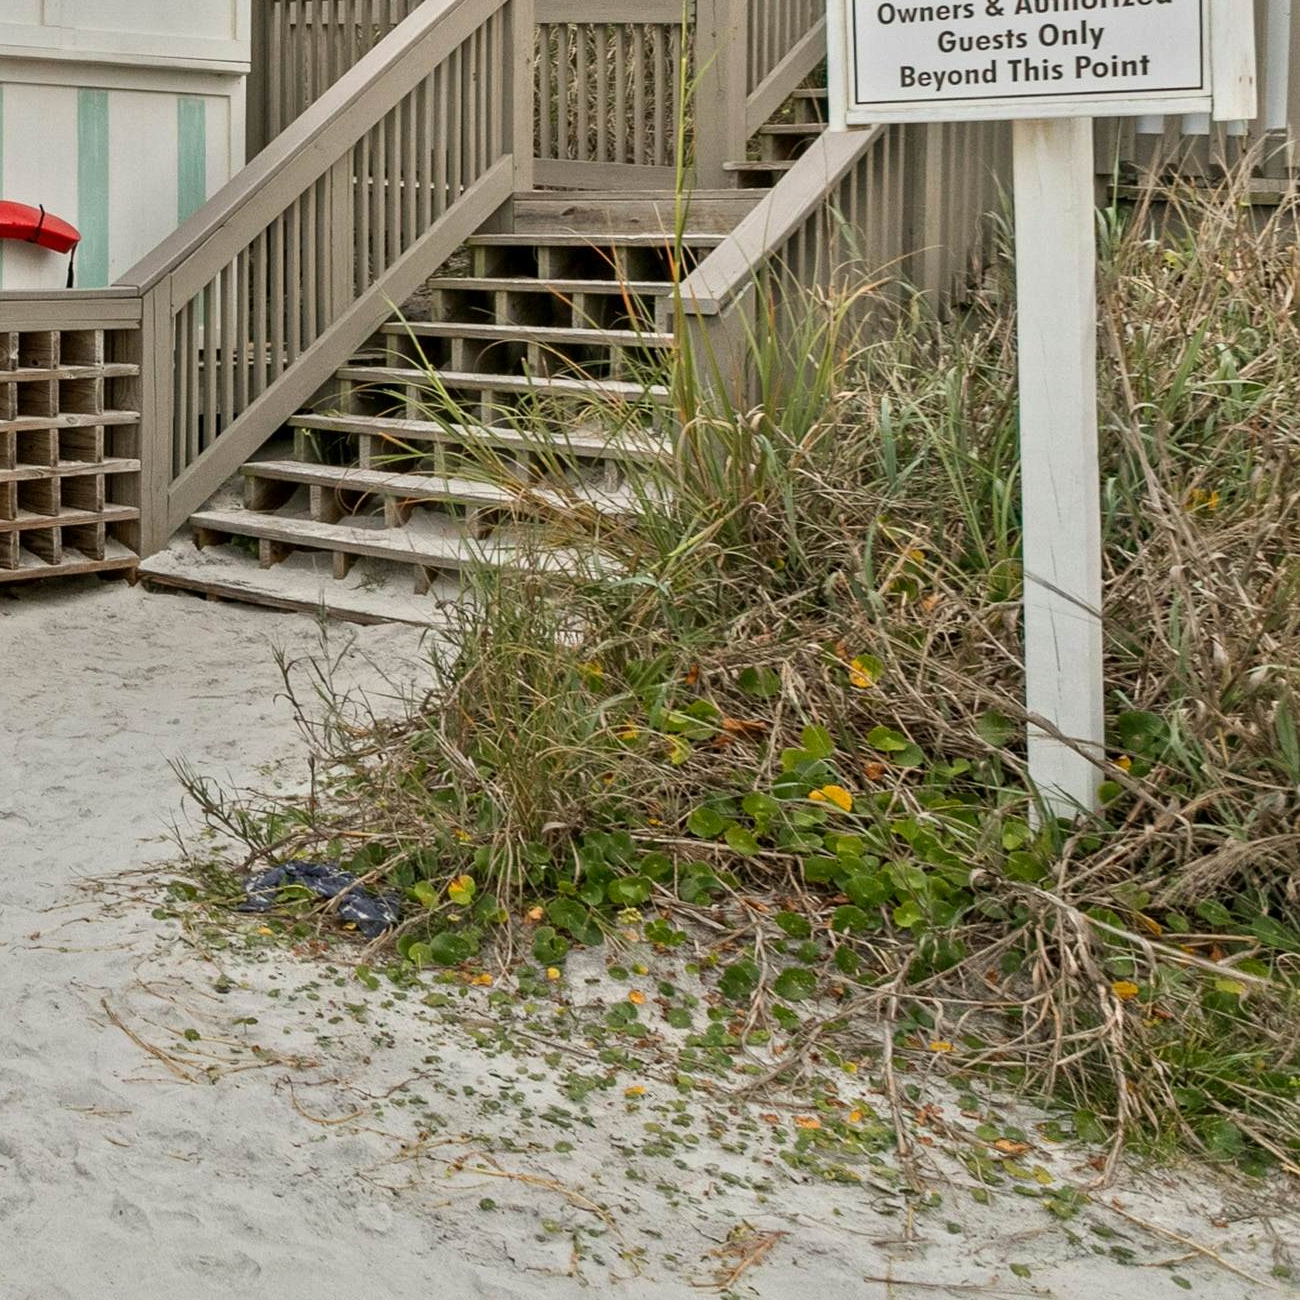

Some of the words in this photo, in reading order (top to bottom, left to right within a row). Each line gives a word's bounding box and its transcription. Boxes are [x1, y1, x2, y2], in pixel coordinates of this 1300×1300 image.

[937, 28, 1027, 54] Guests
[1038, 20, 1104, 50] Only
[900, 60, 996, 91] Beyond
[1008, 57, 1063, 83] This
[1075, 54, 1150, 79] Point
